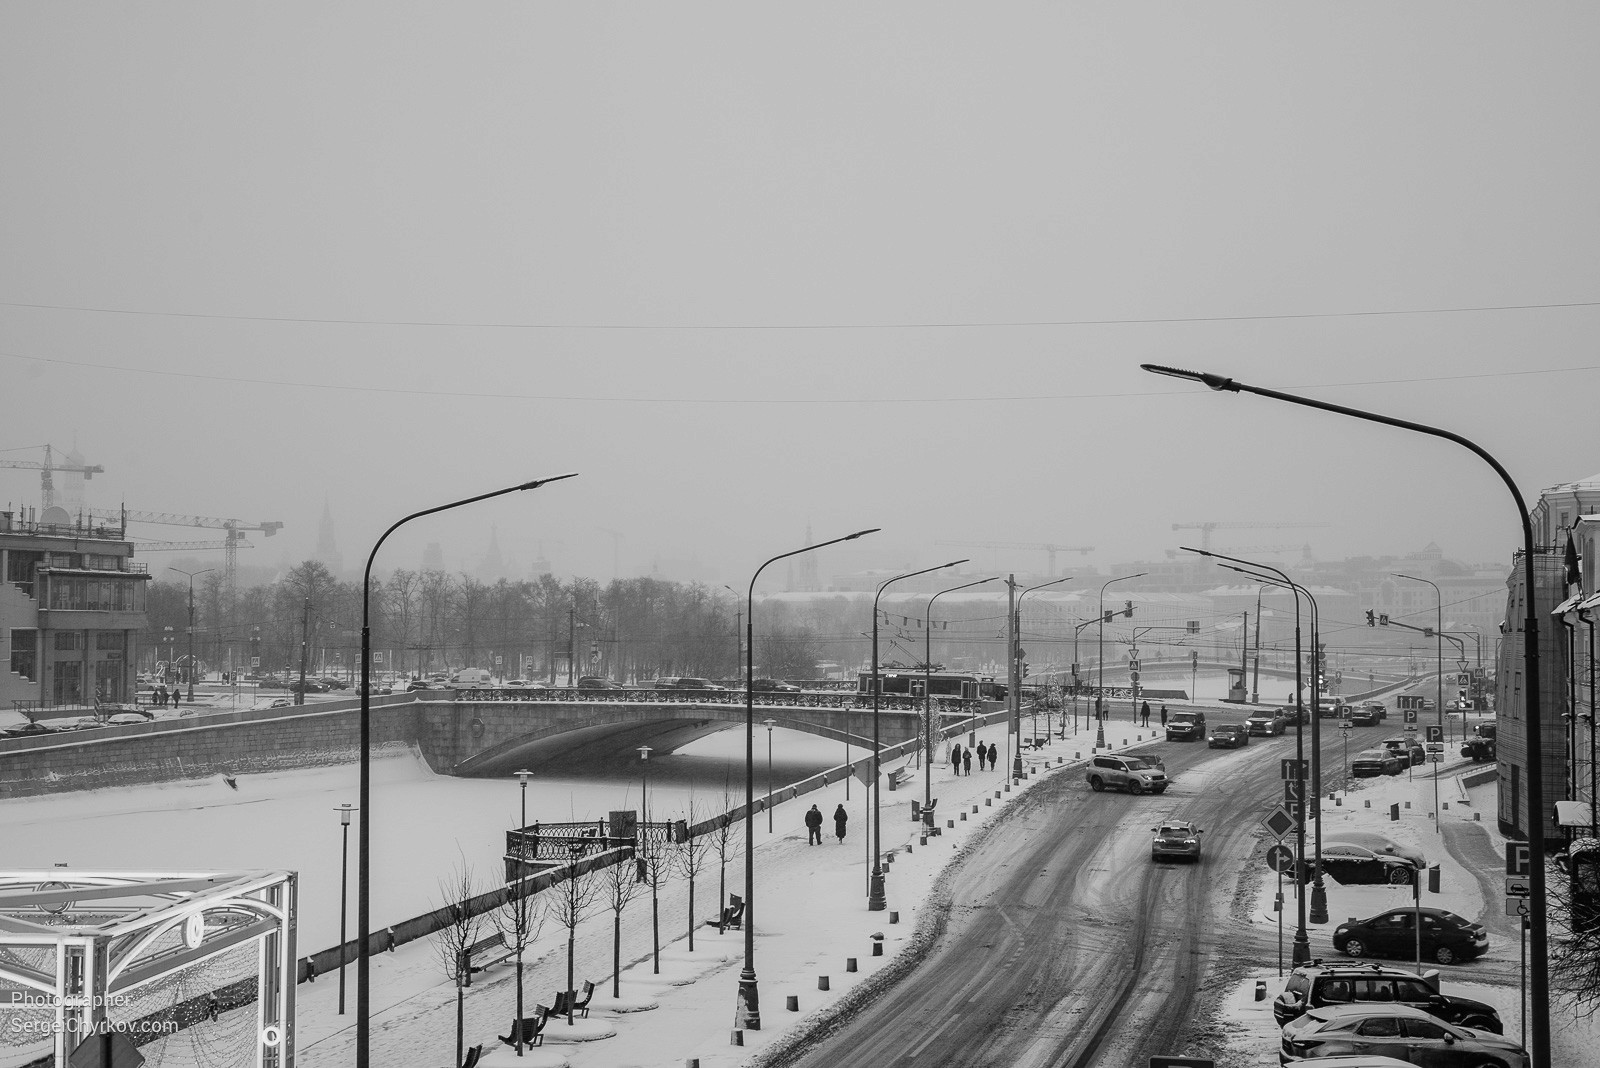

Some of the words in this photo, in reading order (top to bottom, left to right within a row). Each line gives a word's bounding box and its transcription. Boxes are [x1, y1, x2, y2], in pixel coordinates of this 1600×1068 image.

[1342, 707, 1350, 718] P
[1407, 711, 1415, 722] P
[1430, 727, 1440, 741] P
